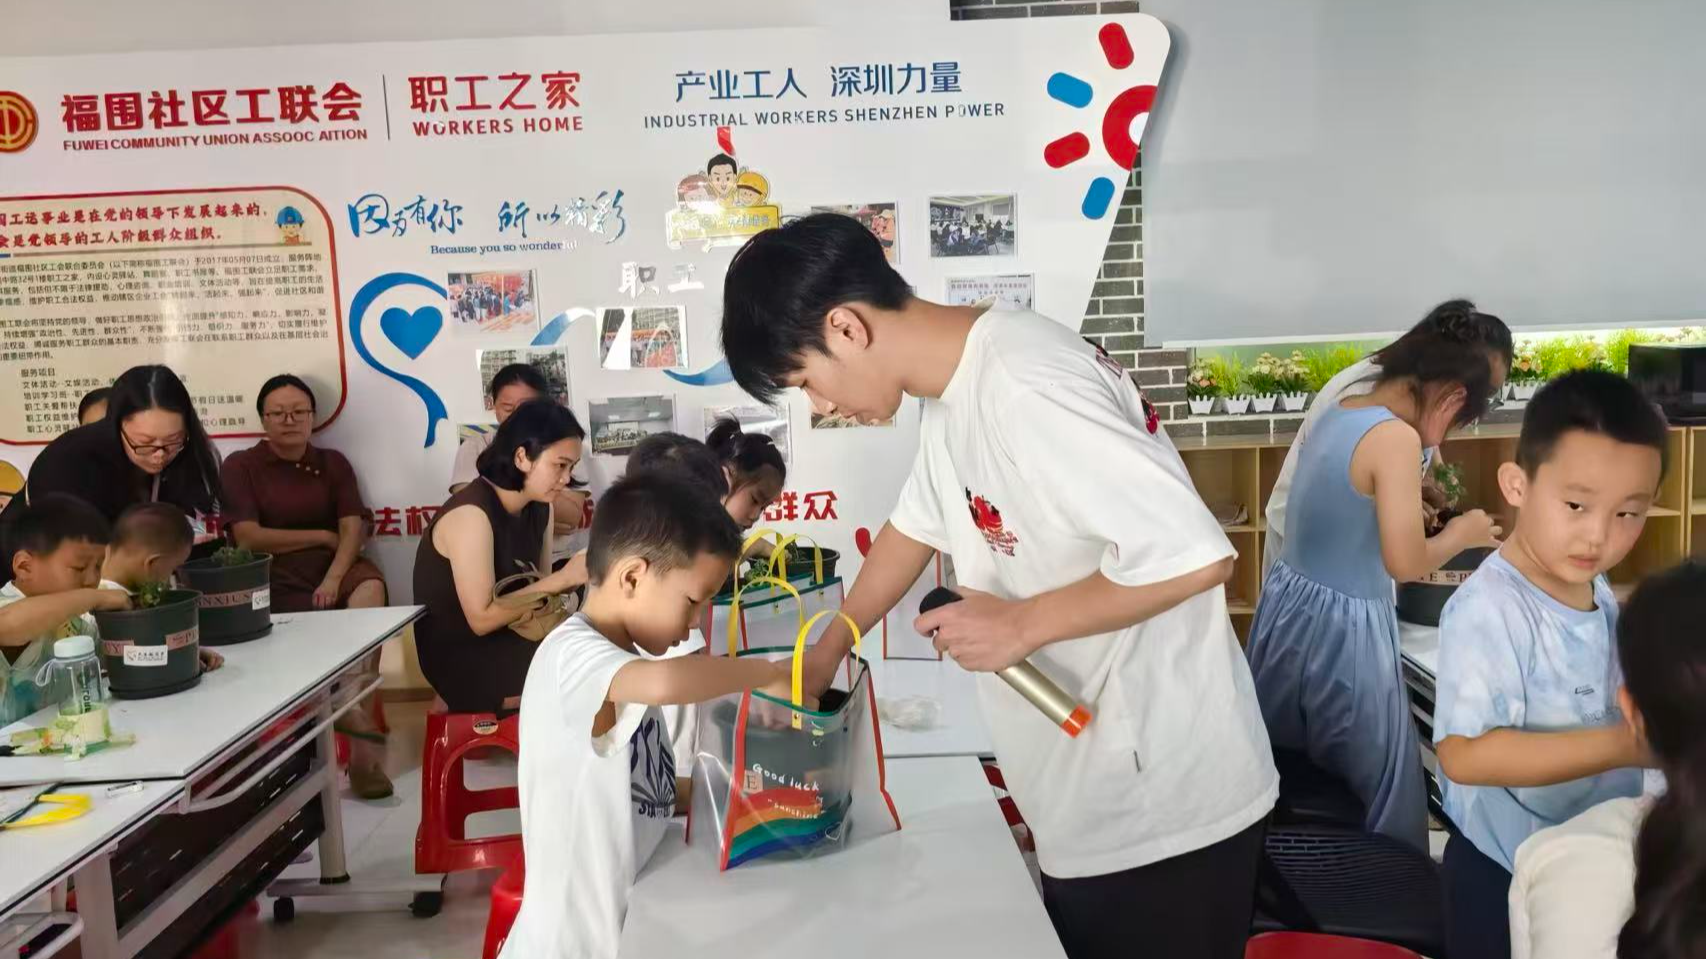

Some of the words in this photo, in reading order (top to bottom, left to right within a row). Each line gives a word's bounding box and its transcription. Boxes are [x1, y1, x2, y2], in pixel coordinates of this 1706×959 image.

[408, 71, 581, 113] 职工之家
[675, 67, 808, 102] 产业工人
[830, 61, 962, 98] 深圳力量
[61, 82, 362, 133] 福围社区工联会
[644, 113, 748, 129] INDUSTRIAL
[754, 110, 838, 125] WORKERS
[844, 105, 938, 122] SHENZHEN
[63, 139, 108, 151] FUWEI
[111, 135, 200, 150] COMMUNITY
[203, 133, 250, 146] UNION
[252, 131, 315, 144] ASSOOC
[318, 129, 368, 141] AITION
[413, 118, 514, 136] WORKERS
[523, 116, 583, 133] HOME
[347, 193, 463, 238] 因为有你
[430, 244, 478, 255] Because
[479, 243, 501, 255] you
[503, 244, 517, 253] so
[618, 261, 705, 299] 职工
[752, 763, 786, 785] Good
[789, 775, 820, 792] luck
